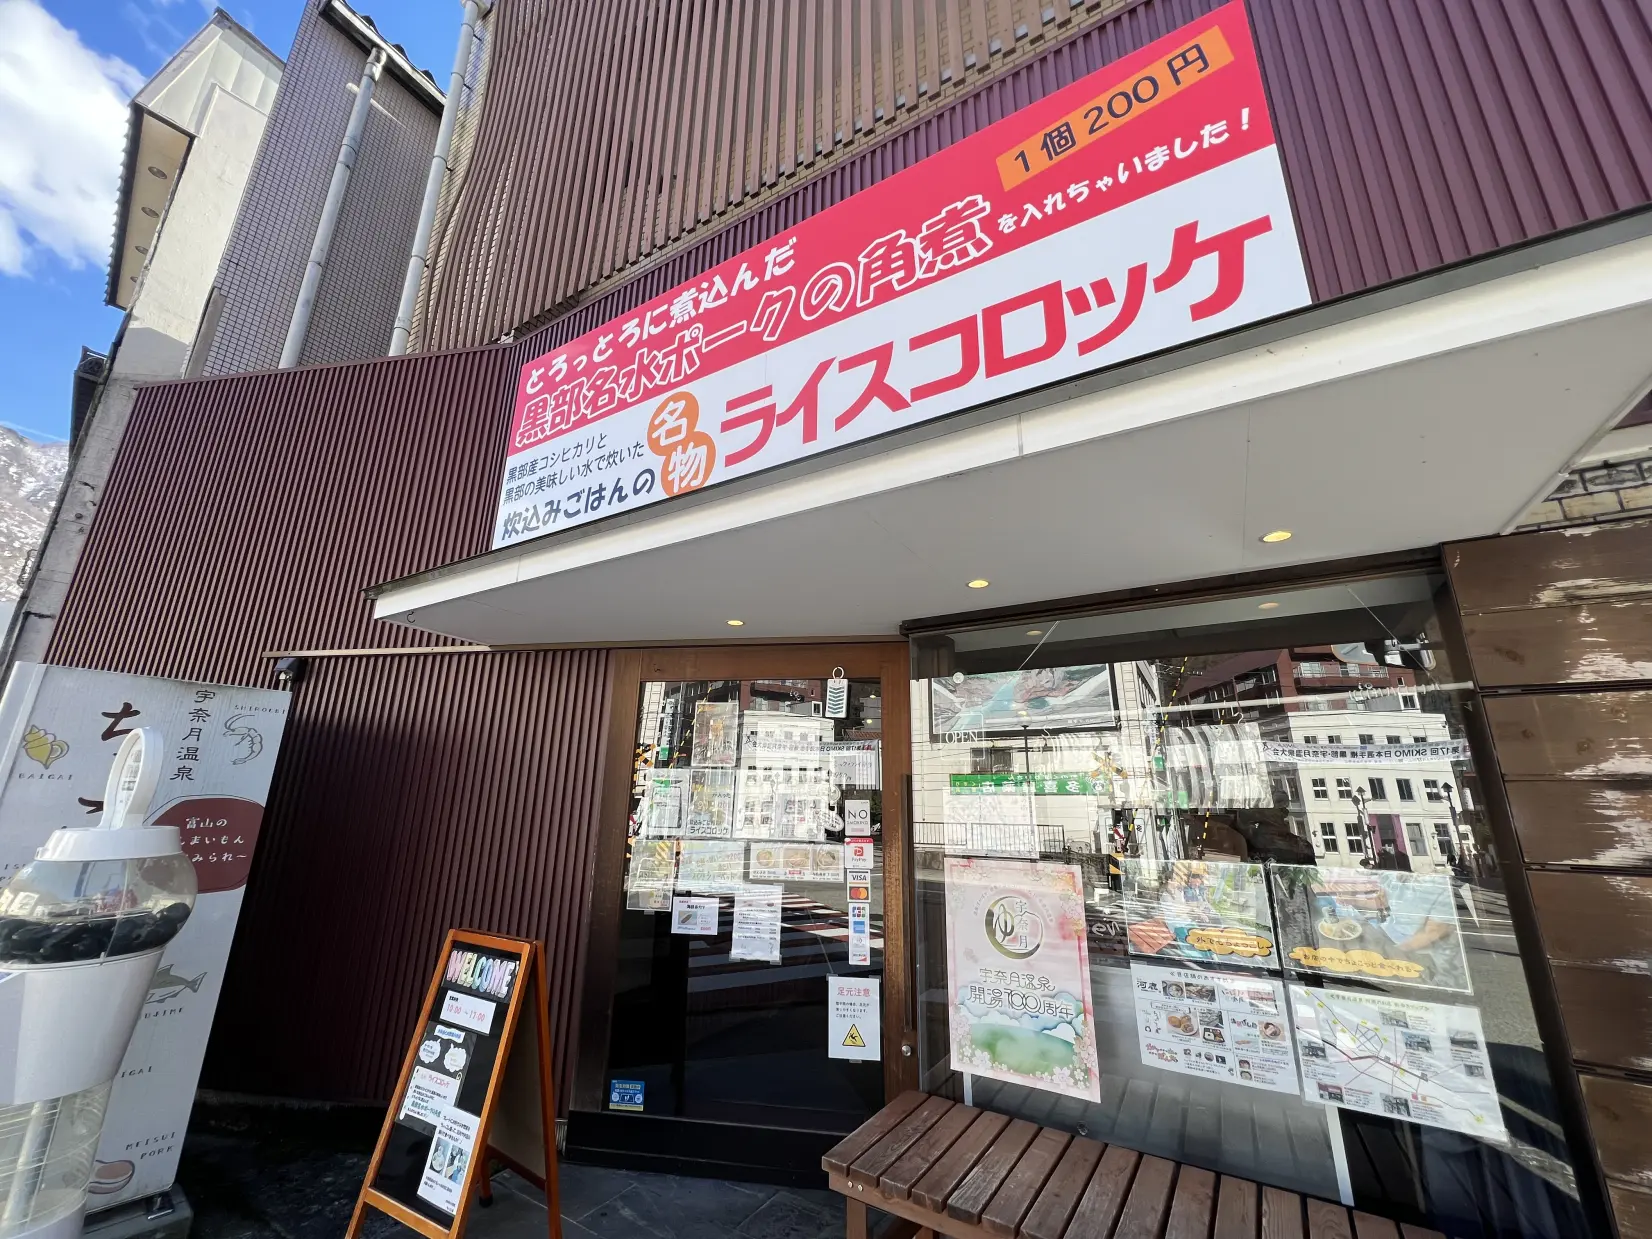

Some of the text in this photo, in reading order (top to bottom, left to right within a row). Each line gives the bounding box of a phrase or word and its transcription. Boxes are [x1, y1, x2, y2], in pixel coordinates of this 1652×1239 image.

[515, 194, 993, 447] 黒部名水ポークの角煮
[526, 236, 798, 395] とろっとろに煮込んだ
[720, 215, 1273, 467] ライスコロッケ
[506, 432, 607, 484] 黒部産コシヒカリと
[503, 441, 645, 506] 黒部の美味しい水で炊いた
[501, 468, 656, 540] 炊込みごはんの
[170, 689, 216, 782] 宇奈月温泉
[945, 730, 979, 744] OPEN
[18, 772, 74, 781] BAIGAI
[185, 816, 228, 830] 富山の
[847, 809, 868, 819] NO
[690, 826, 728, 836] ライスコロッケ
[836, 986, 871, 997] 足元注意
[979, 967, 1056, 992] 宇奈月温泉
[967, 985, 1075, 1019] 開湯100周年
[125, 1131, 176, 1151] MEISUI
[140, 1145, 175, 1160] PORK
